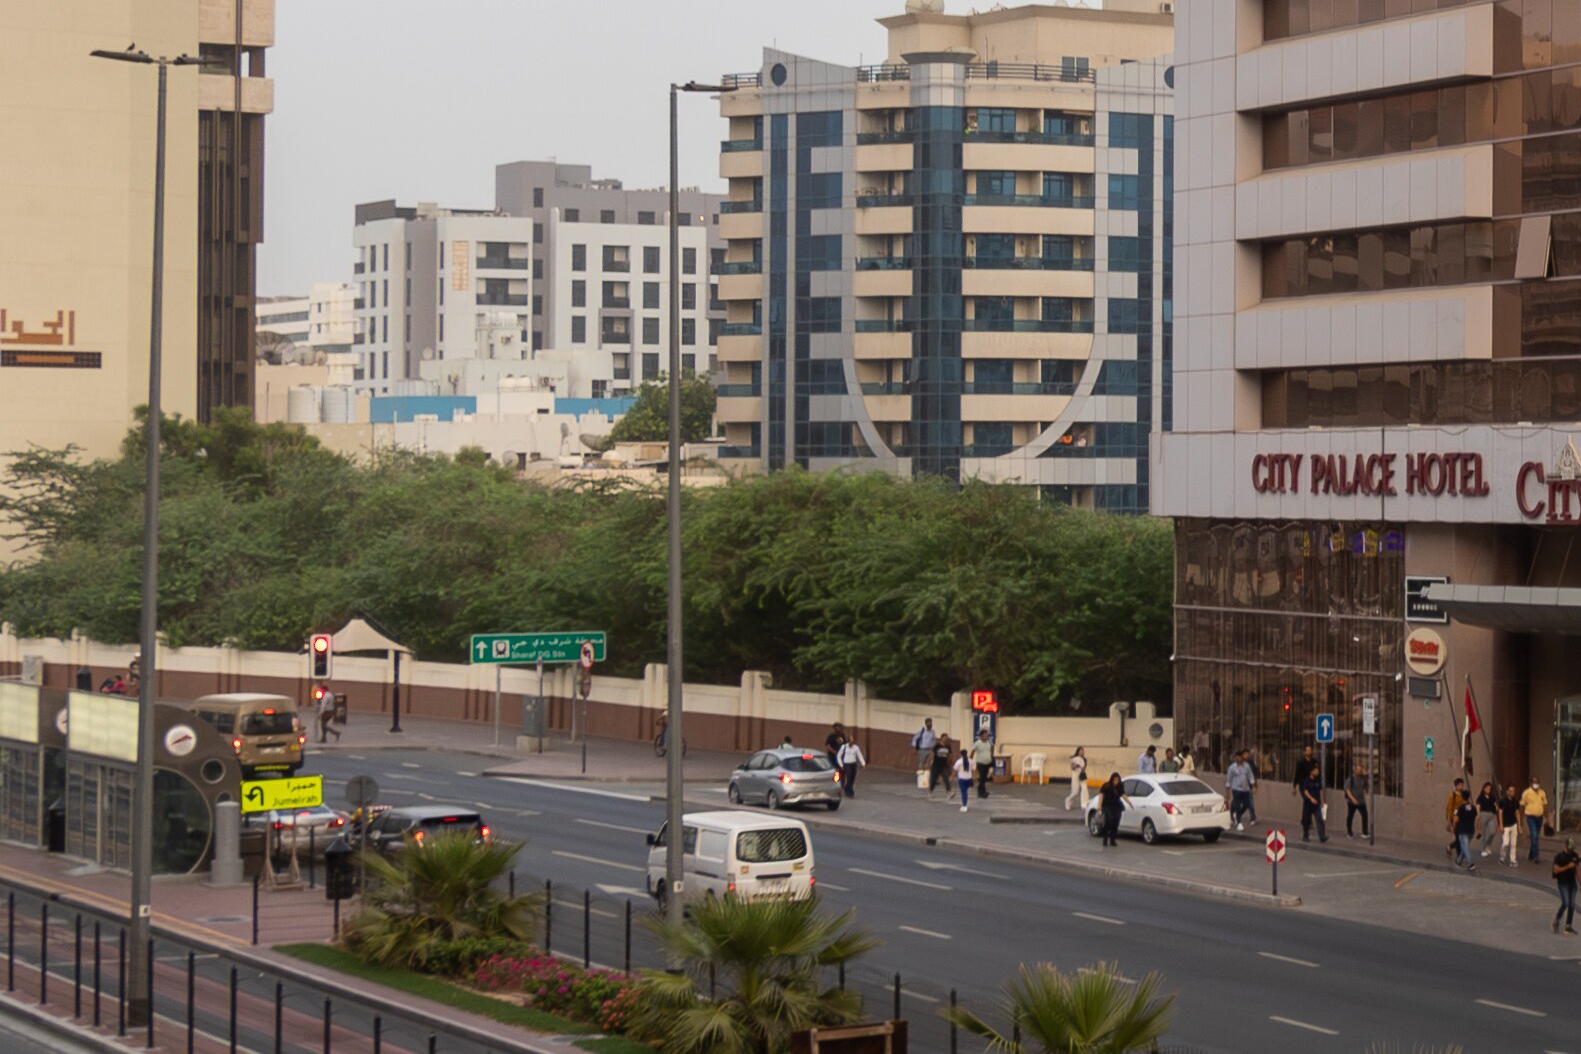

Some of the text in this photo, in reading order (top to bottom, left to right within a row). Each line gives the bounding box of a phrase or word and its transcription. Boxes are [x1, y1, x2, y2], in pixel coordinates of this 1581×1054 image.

[1252, 452, 1490, 497] CITY PALACE HOTEL
[511, 650, 537, 659] Sharaf
[538, 650, 551, 659] DG
[286, 781, 317, 793] جميرا
[272, 795, 318, 807] Jumeirah
